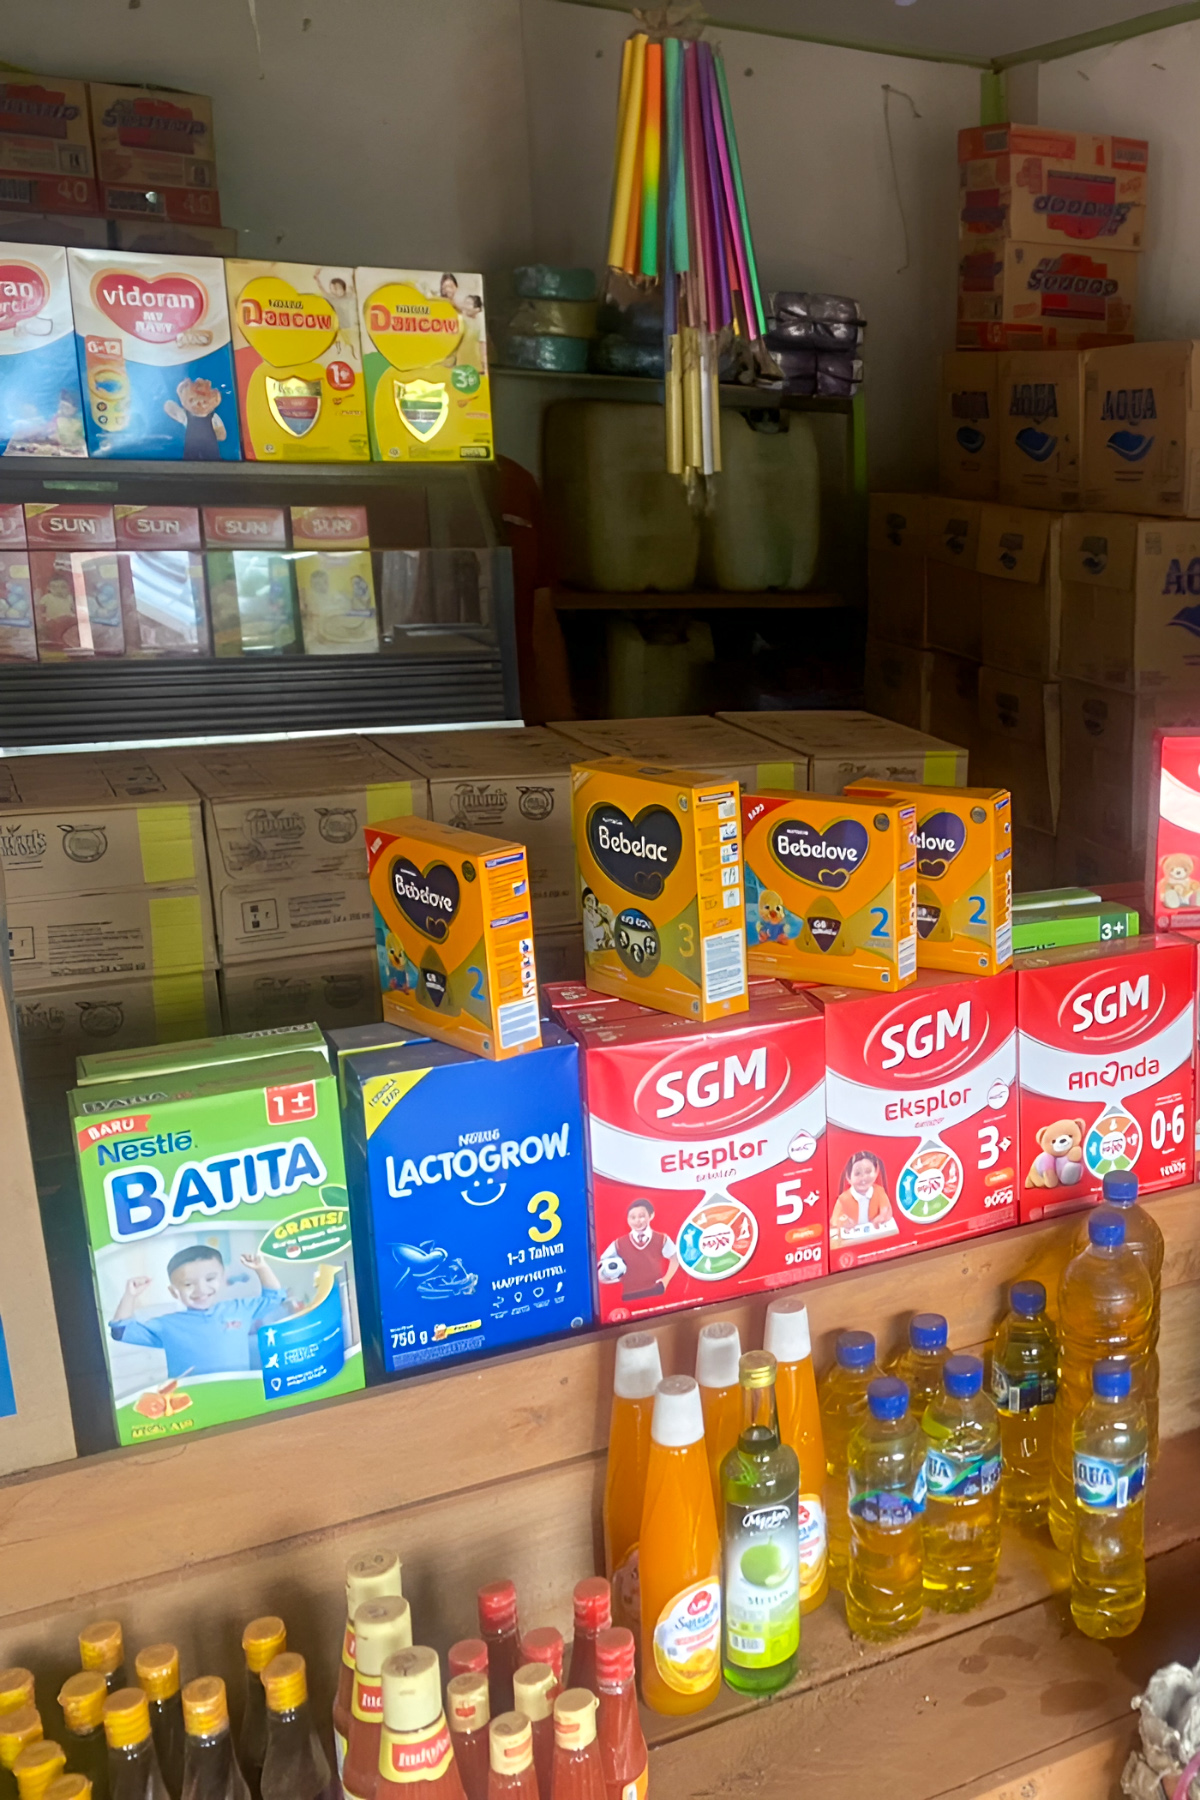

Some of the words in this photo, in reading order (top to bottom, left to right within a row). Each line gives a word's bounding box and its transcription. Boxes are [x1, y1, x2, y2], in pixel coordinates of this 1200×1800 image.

[103, 285, 195, 309] vidoran
[240, 298, 332, 330] Dancow
[370, 304, 460, 333] Dancow
[1101, 387, 1158, 425] AQUA
[49, 517, 96, 534] SUN
[137, 518, 180, 534] SUN
[224, 519, 270, 535] SUN
[598, 825, 668, 863] Bebelac
[777, 834, 858, 862] Bebelove
[394, 873, 453, 913] Bebelove
[870, 906, 890, 938] 2
[968, 895, 988, 925] 2
[678, 922, 695, 958] 3
[1101, 920, 1124, 941] 3+
[466, 965, 486, 1001] 2
[1072, 974, 1150, 1033] SGM
[880, 1000, 971, 1071] SGM
[655, 1046, 767, 1119] SGM
[271, 1091, 311, 1117] 1+
[884, 1087, 972, 1122] Eksplor
[87, 1117, 135, 1141] BARU
[385, 1122, 570, 1199] LACTOGROW
[660, 1138, 768, 1174] Eksplor
[110, 1142, 321, 1236] BATITA
[273, 1211, 345, 1241] GRATIS!
[527, 1190, 563, 1243] 3
[506, 1250, 526, 1266] 1-3
[784, 1247, 822, 1266] 900g
[390, 1330, 416, 1349] 750
[419, 1330, 429, 1346] g
[1077, 1462, 1114, 1489] QUA
